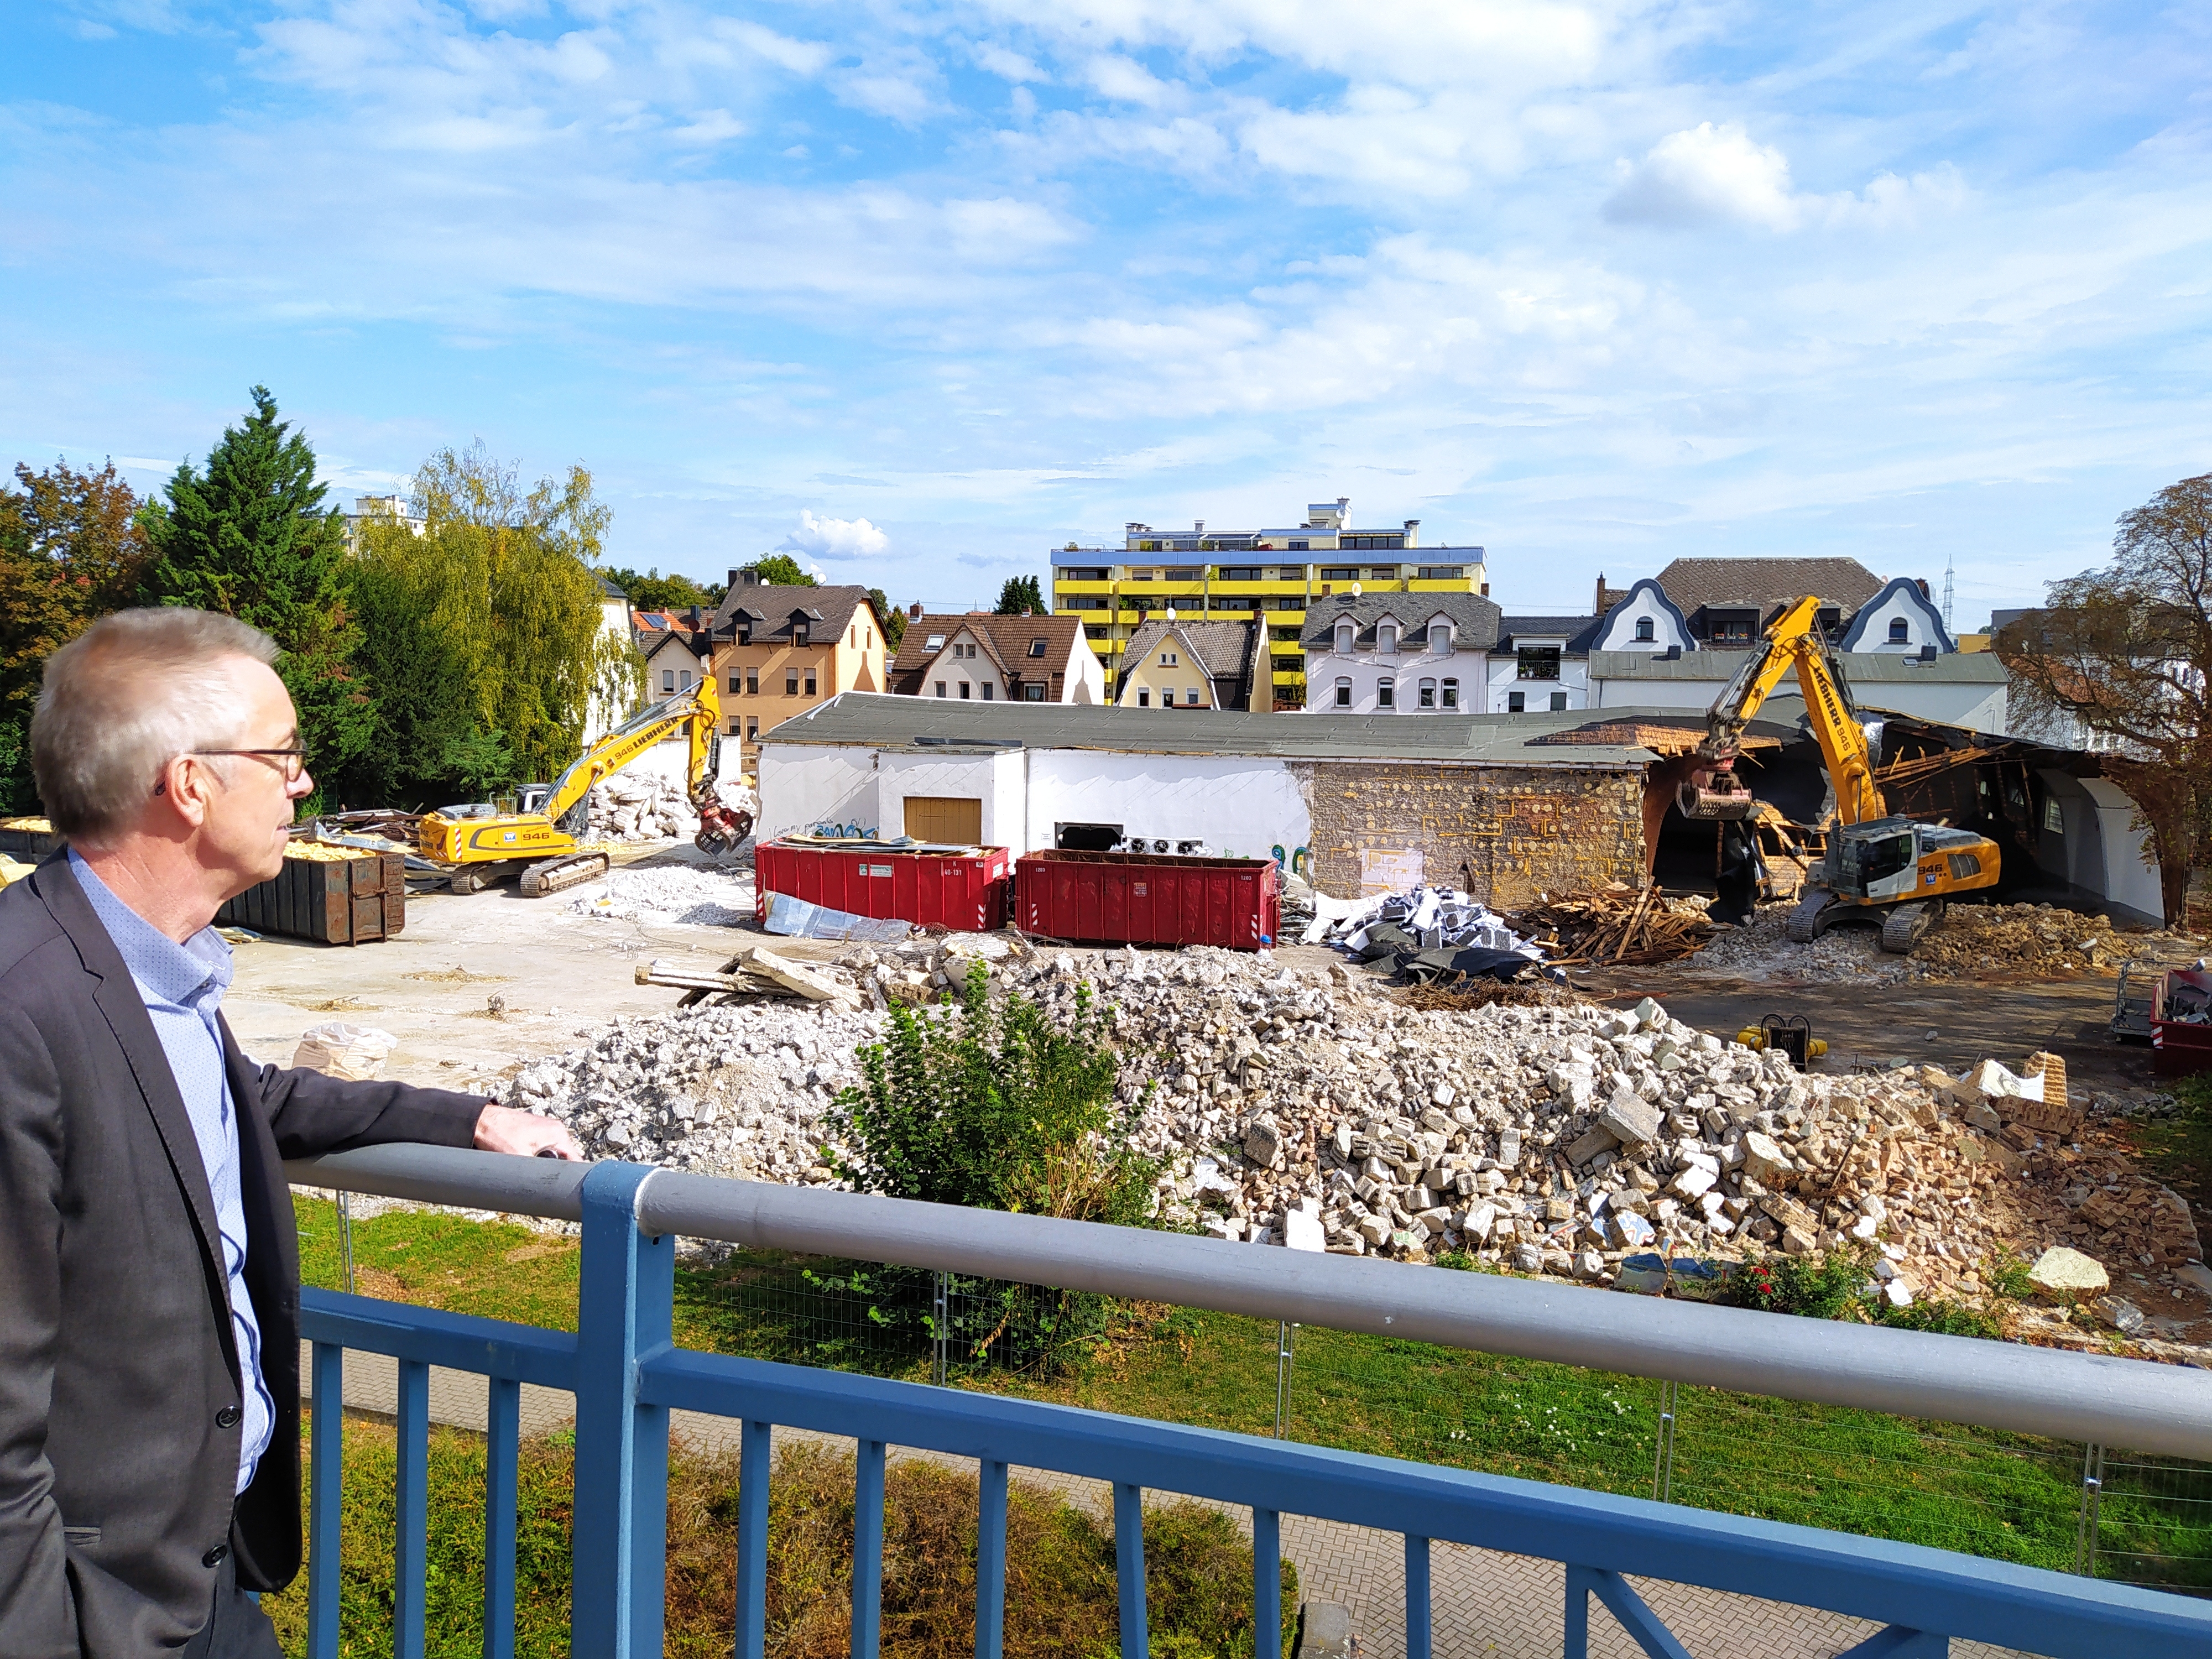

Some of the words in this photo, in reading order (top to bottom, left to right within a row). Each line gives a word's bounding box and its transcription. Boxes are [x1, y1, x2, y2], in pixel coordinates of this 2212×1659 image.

[1814, 666, 1841, 728] LIEBHERR
[1837, 727, 1850, 751] 946
[614, 745, 634, 760] 946
[633, 717, 680, 749] LIEBHERR
[523, 832, 550, 841] 946
[1918, 863, 1943, 875] 946
